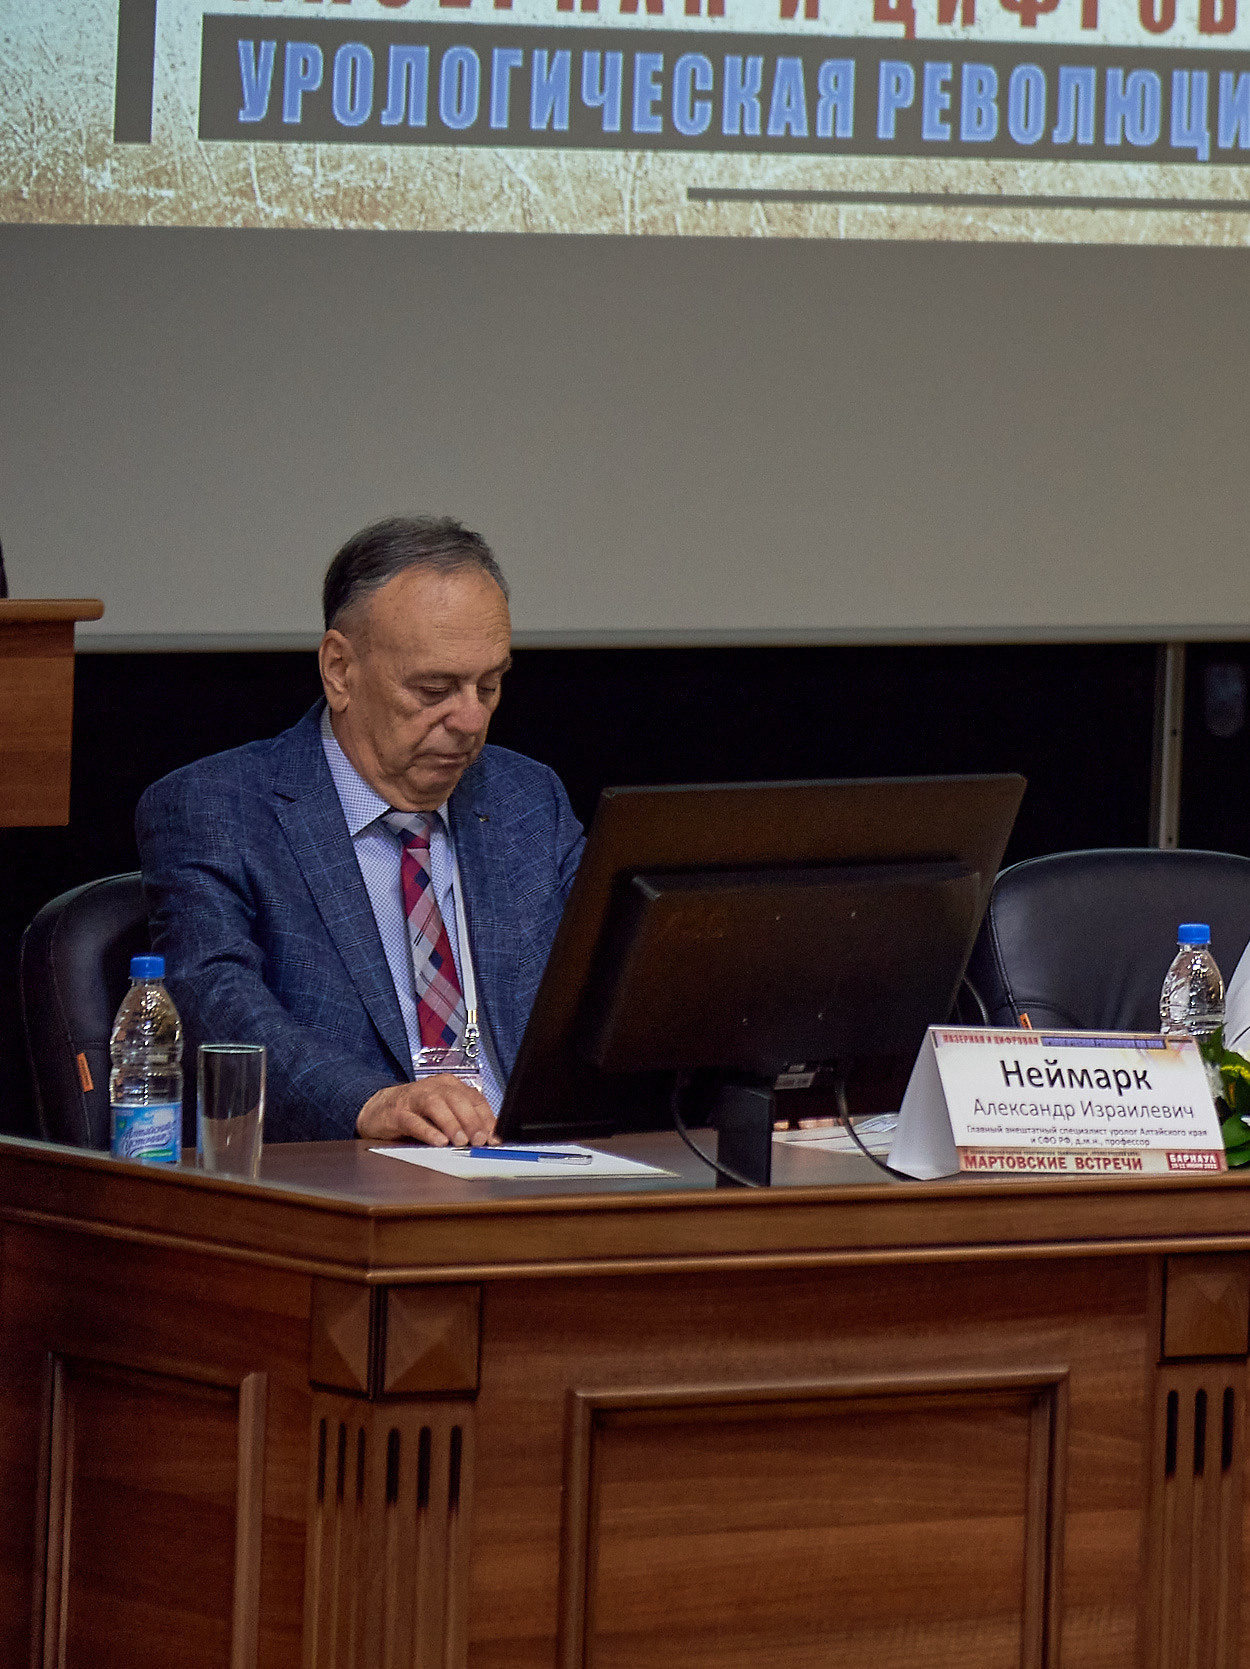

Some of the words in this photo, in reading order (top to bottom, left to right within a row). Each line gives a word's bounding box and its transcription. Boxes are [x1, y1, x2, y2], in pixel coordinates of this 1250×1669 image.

[238, 40, 856, 138] УРОЛОГИЧЕСКАЯ
[1000, 1059, 1153, 1096] Неймарк
[973, 1099, 1075, 1120] Александр
[1080, 1101, 1194, 1120] Израилевич
[967, 1125, 1002, 1133] Главный
[1005, 1126, 1057, 1134] внештатный
[1140, 1128, 1186, 1136] Алтайского
[1038, 1136, 1057, 1144] СФО
[1105, 1138, 1150, 1146] профессор
[964, 1155, 1067, 1169] МАРТОВСКИЕ
[1075, 1156, 1143, 1170] ВСТРЕЧИ
[1169, 1154, 1216, 1163] БАРНАУЛ
